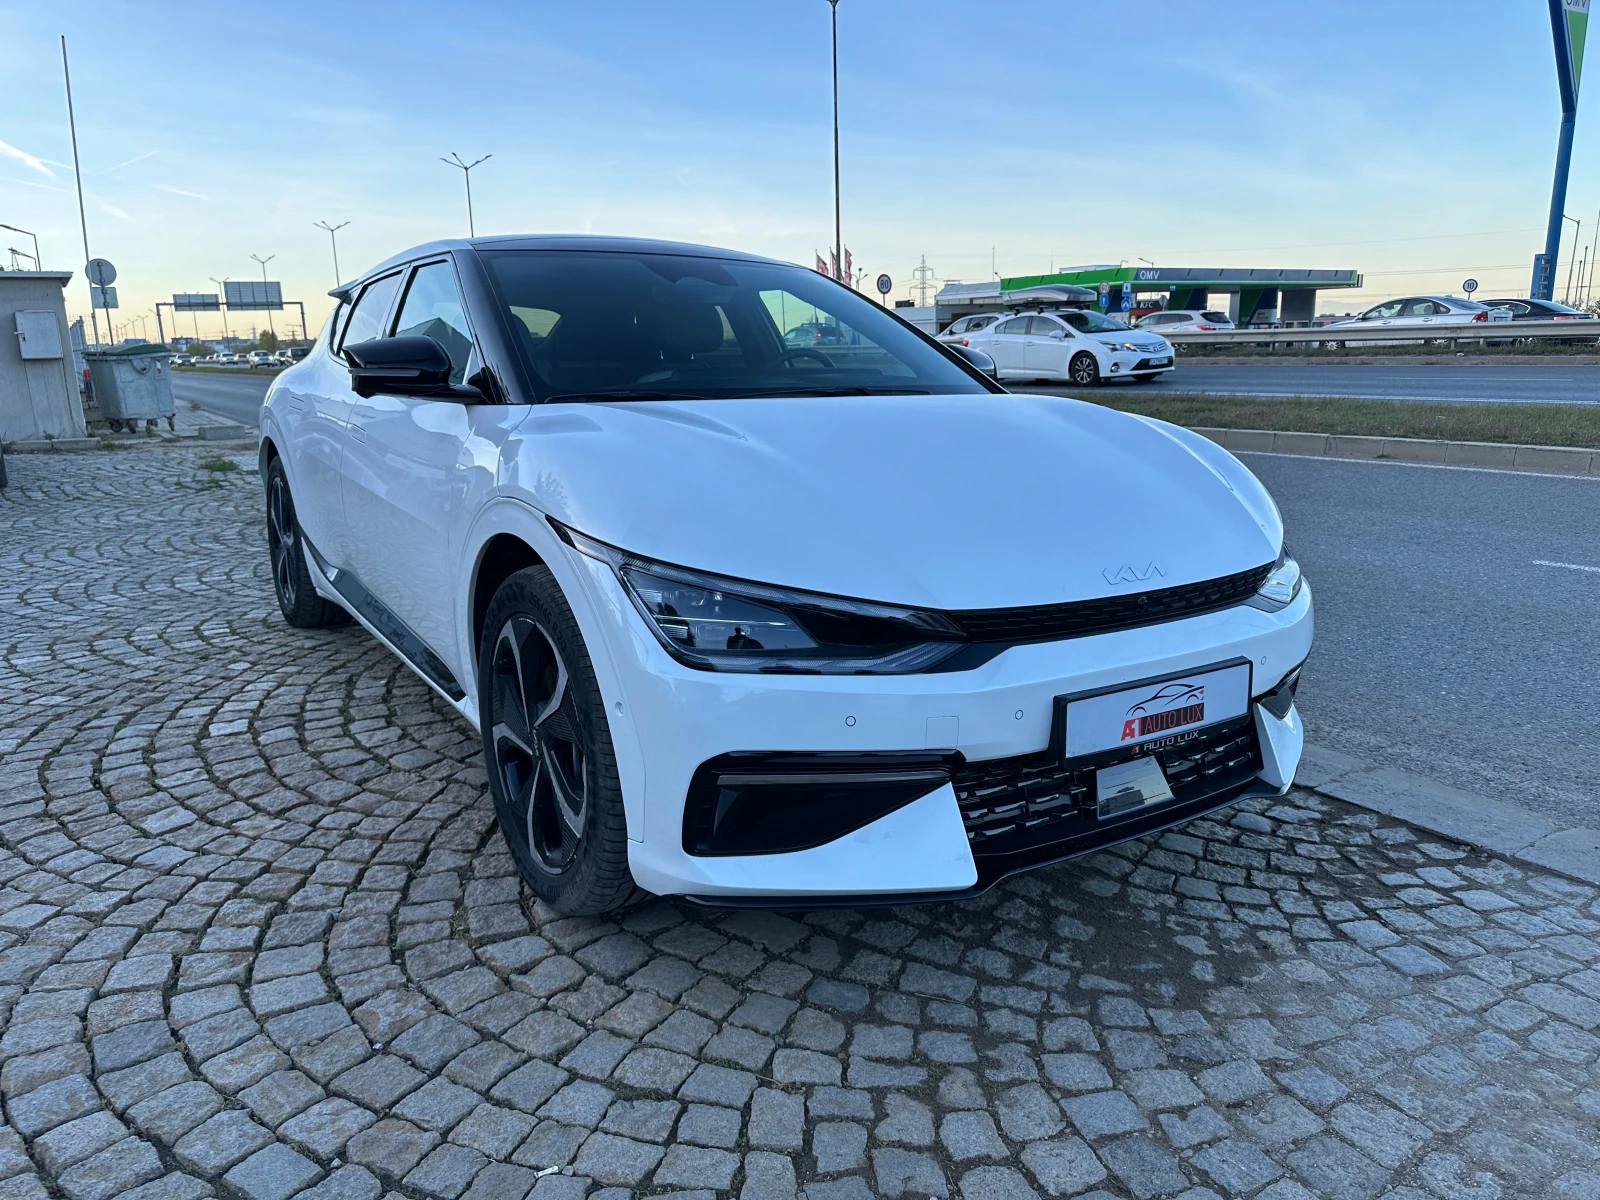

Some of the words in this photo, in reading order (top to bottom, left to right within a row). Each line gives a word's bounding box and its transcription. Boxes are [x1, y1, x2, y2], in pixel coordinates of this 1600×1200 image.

[1139, 270, 1160, 280] OMV
[880, 279, 889, 290] 80
[1466, 282, 1475, 290] 10
[1140, 301, 1154, 309] KFC
[1121, 717, 1143, 741] A1
[1144, 710, 1177, 734] AUTO
[1180, 704, 1203, 725] LUX
[1144, 737, 1174, 751] AUTO
[1177, 730, 1199, 743] LUX
